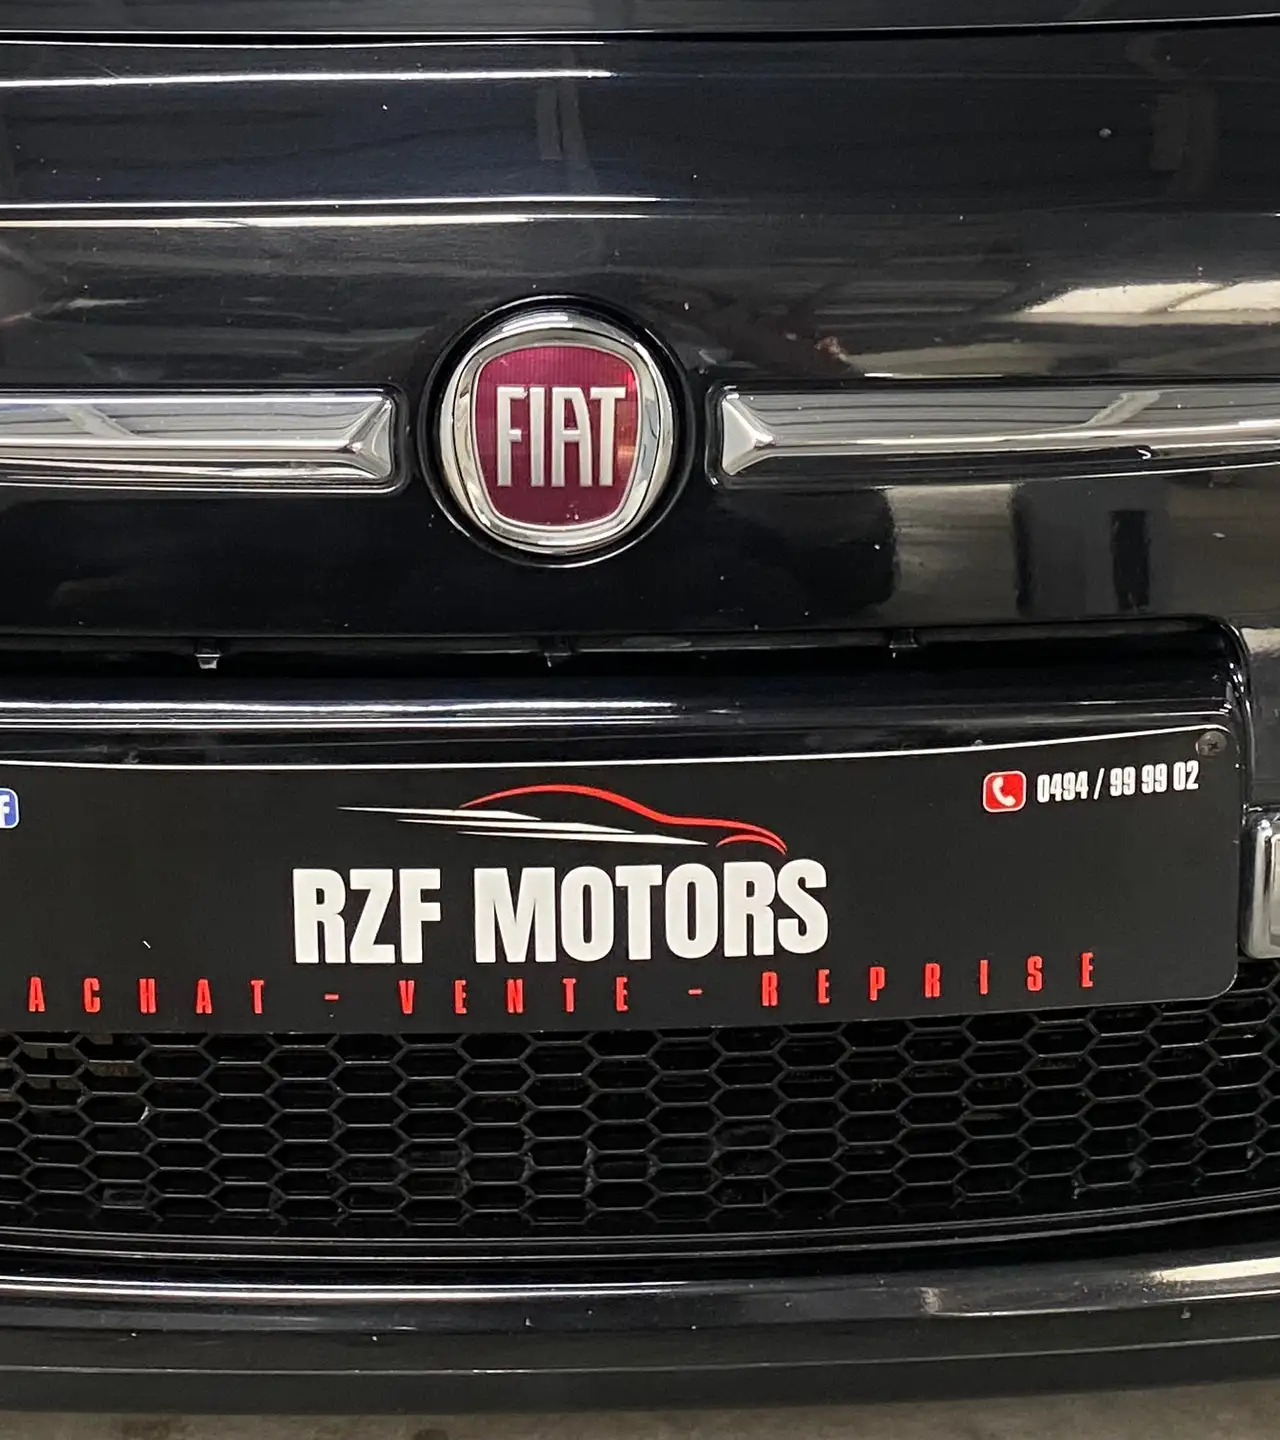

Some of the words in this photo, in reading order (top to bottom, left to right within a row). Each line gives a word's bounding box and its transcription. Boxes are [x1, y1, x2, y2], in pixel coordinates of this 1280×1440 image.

[496, 386, 626, 487] FIAT
[1036, 770, 1089, 803] 0494
[1093, 767, 1105, 800] /
[1109, 766, 1136, 797] 99
[1141, 763, 1168, 794] 99
[1172, 759, 1199, 791] 02
[292, 868, 442, 964] RZF
[473, 858, 829, 964] MOTORS
[27, 976, 265, 1015] ACHAT
[398, 976, 629, 1015] VENTE
[760, 951, 1094, 1007] REPRISE
